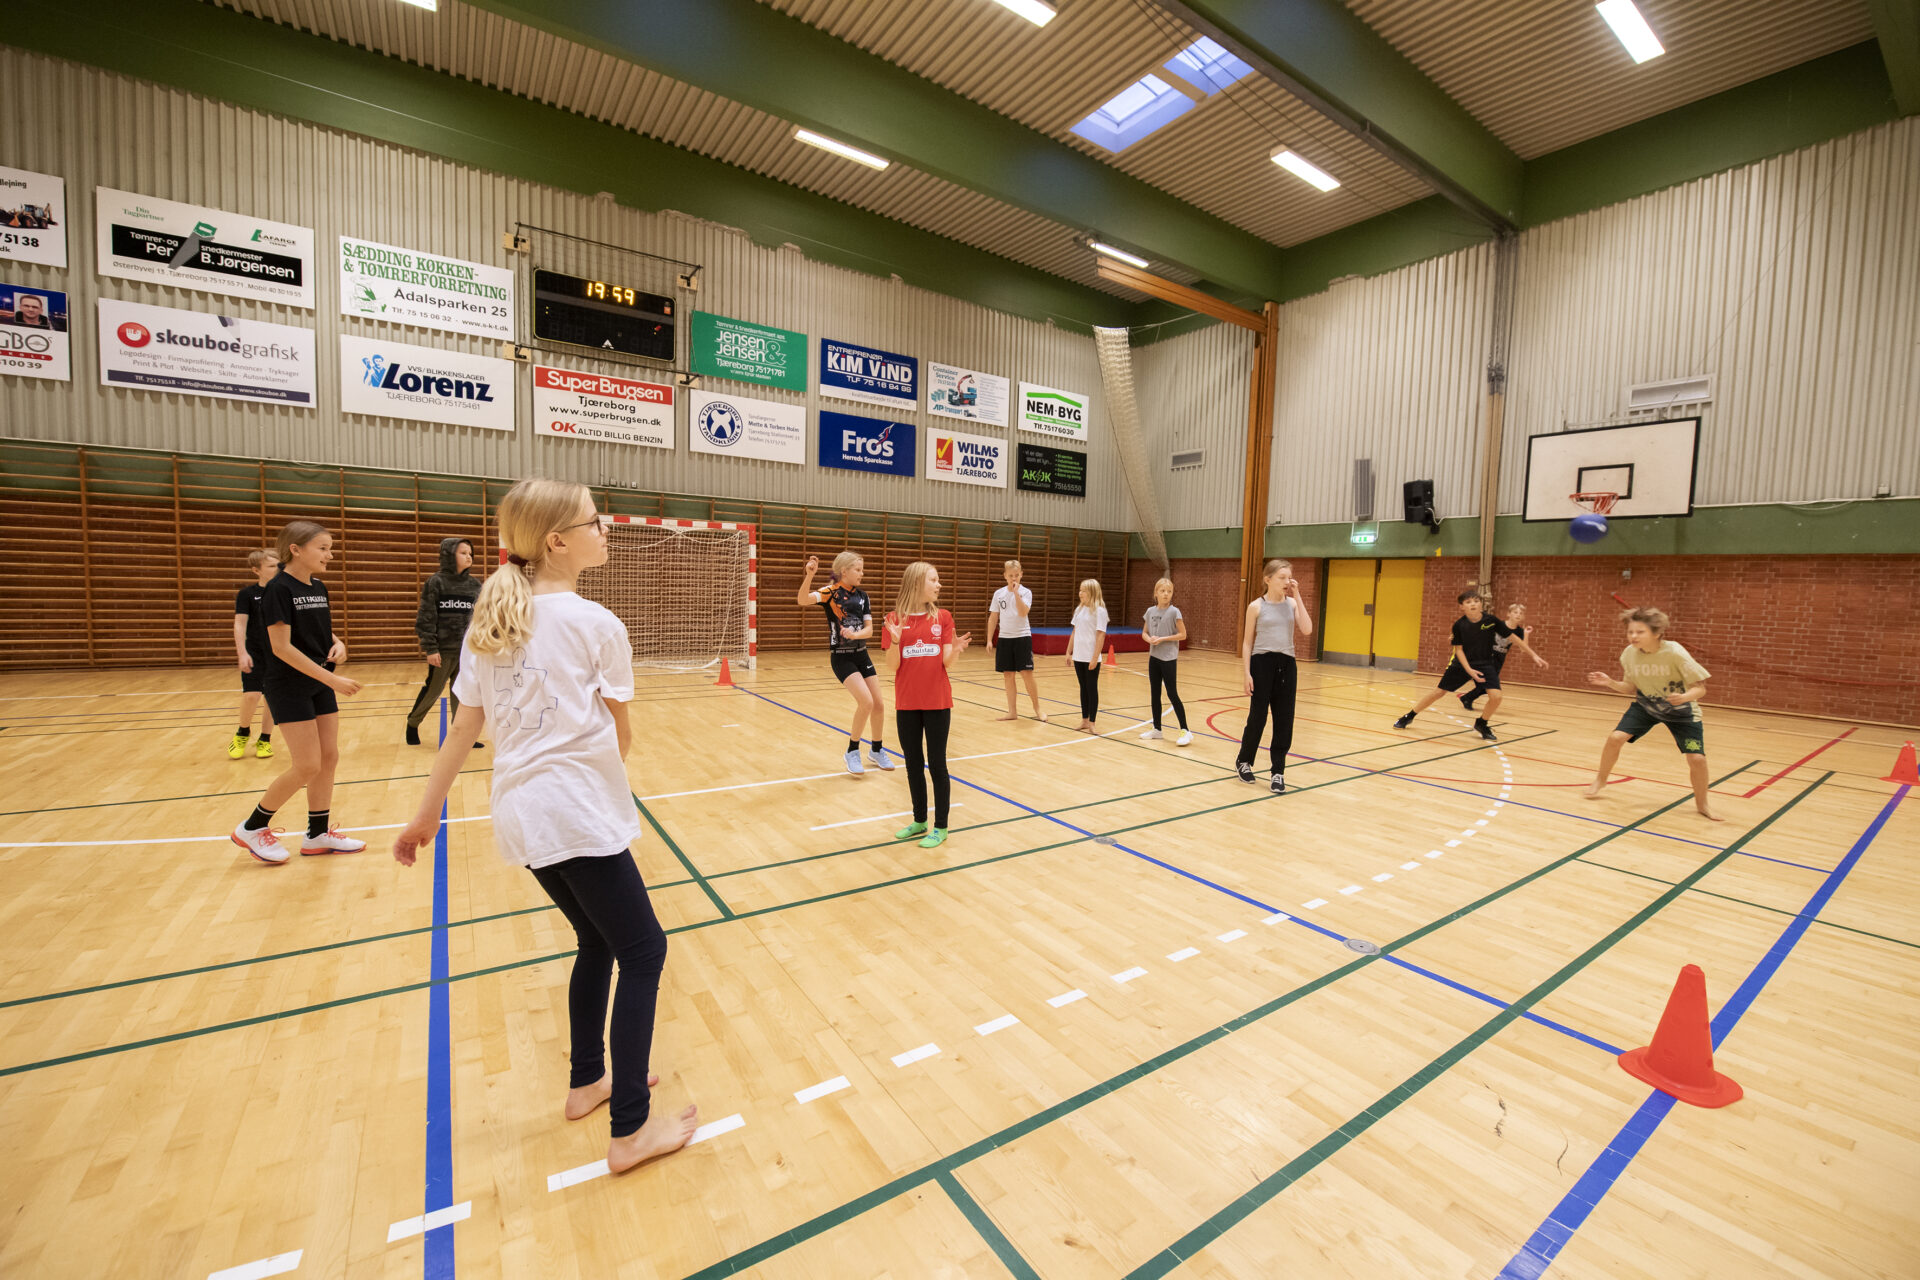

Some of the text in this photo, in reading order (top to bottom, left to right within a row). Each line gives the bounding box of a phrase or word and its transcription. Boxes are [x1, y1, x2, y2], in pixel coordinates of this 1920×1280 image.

[122, 208, 165, 222] Tagpartner
[135, 206, 150, 214] Din
[145, 242, 174, 257] Per
[200, 245, 264, 262] snedkermester
[200, 252, 295, 279] B. Jørgensen
[342, 242, 479, 281] SÆDDING KØKKEN-
[112, 261, 155, 275] Østerbyvej
[168, 270, 208, 282] Tjæreborg
[343, 258, 354, 273] &
[358, 260, 507, 301] TØMRERFORRETNING
[587, 282, 634, 305] 19:59
[394, 287, 487, 314] Ådalsparken
[491, 306, 507, 318] 25
[119, 349, 299, 378] Logodesign Firmaprofilering Annoncer Tryksager
[132, 360, 151, 368] Print
[160, 362, 174, 370] Plot
[180, 365, 213, 375] Websites
[218, 369, 237, 378] Skilte
[242, 373, 289, 384] Autoreklamer
[715, 357, 755, 373] Tjæreborg
[932, 365, 959, 376] Container
[381, 362, 494, 402] Lorenz
[426, 368, 486, 382] BLIKKENSLAGER
[386, 391, 481, 411] TJÆREBORG 75175461
[578, 396, 636, 413] Tjæreborg
[549, 406, 662, 426] www.superbrugsen.dk
[551, 421, 663, 444] OK ALTID BILLIG BENZIN
[842, 453, 863, 462] Herreds
[957, 441, 999, 458] WILMS
[961, 455, 995, 470] AUTO
[956, 468, 998, 480] TJÆREBORG
[440, 600, 472, 609] adidas
